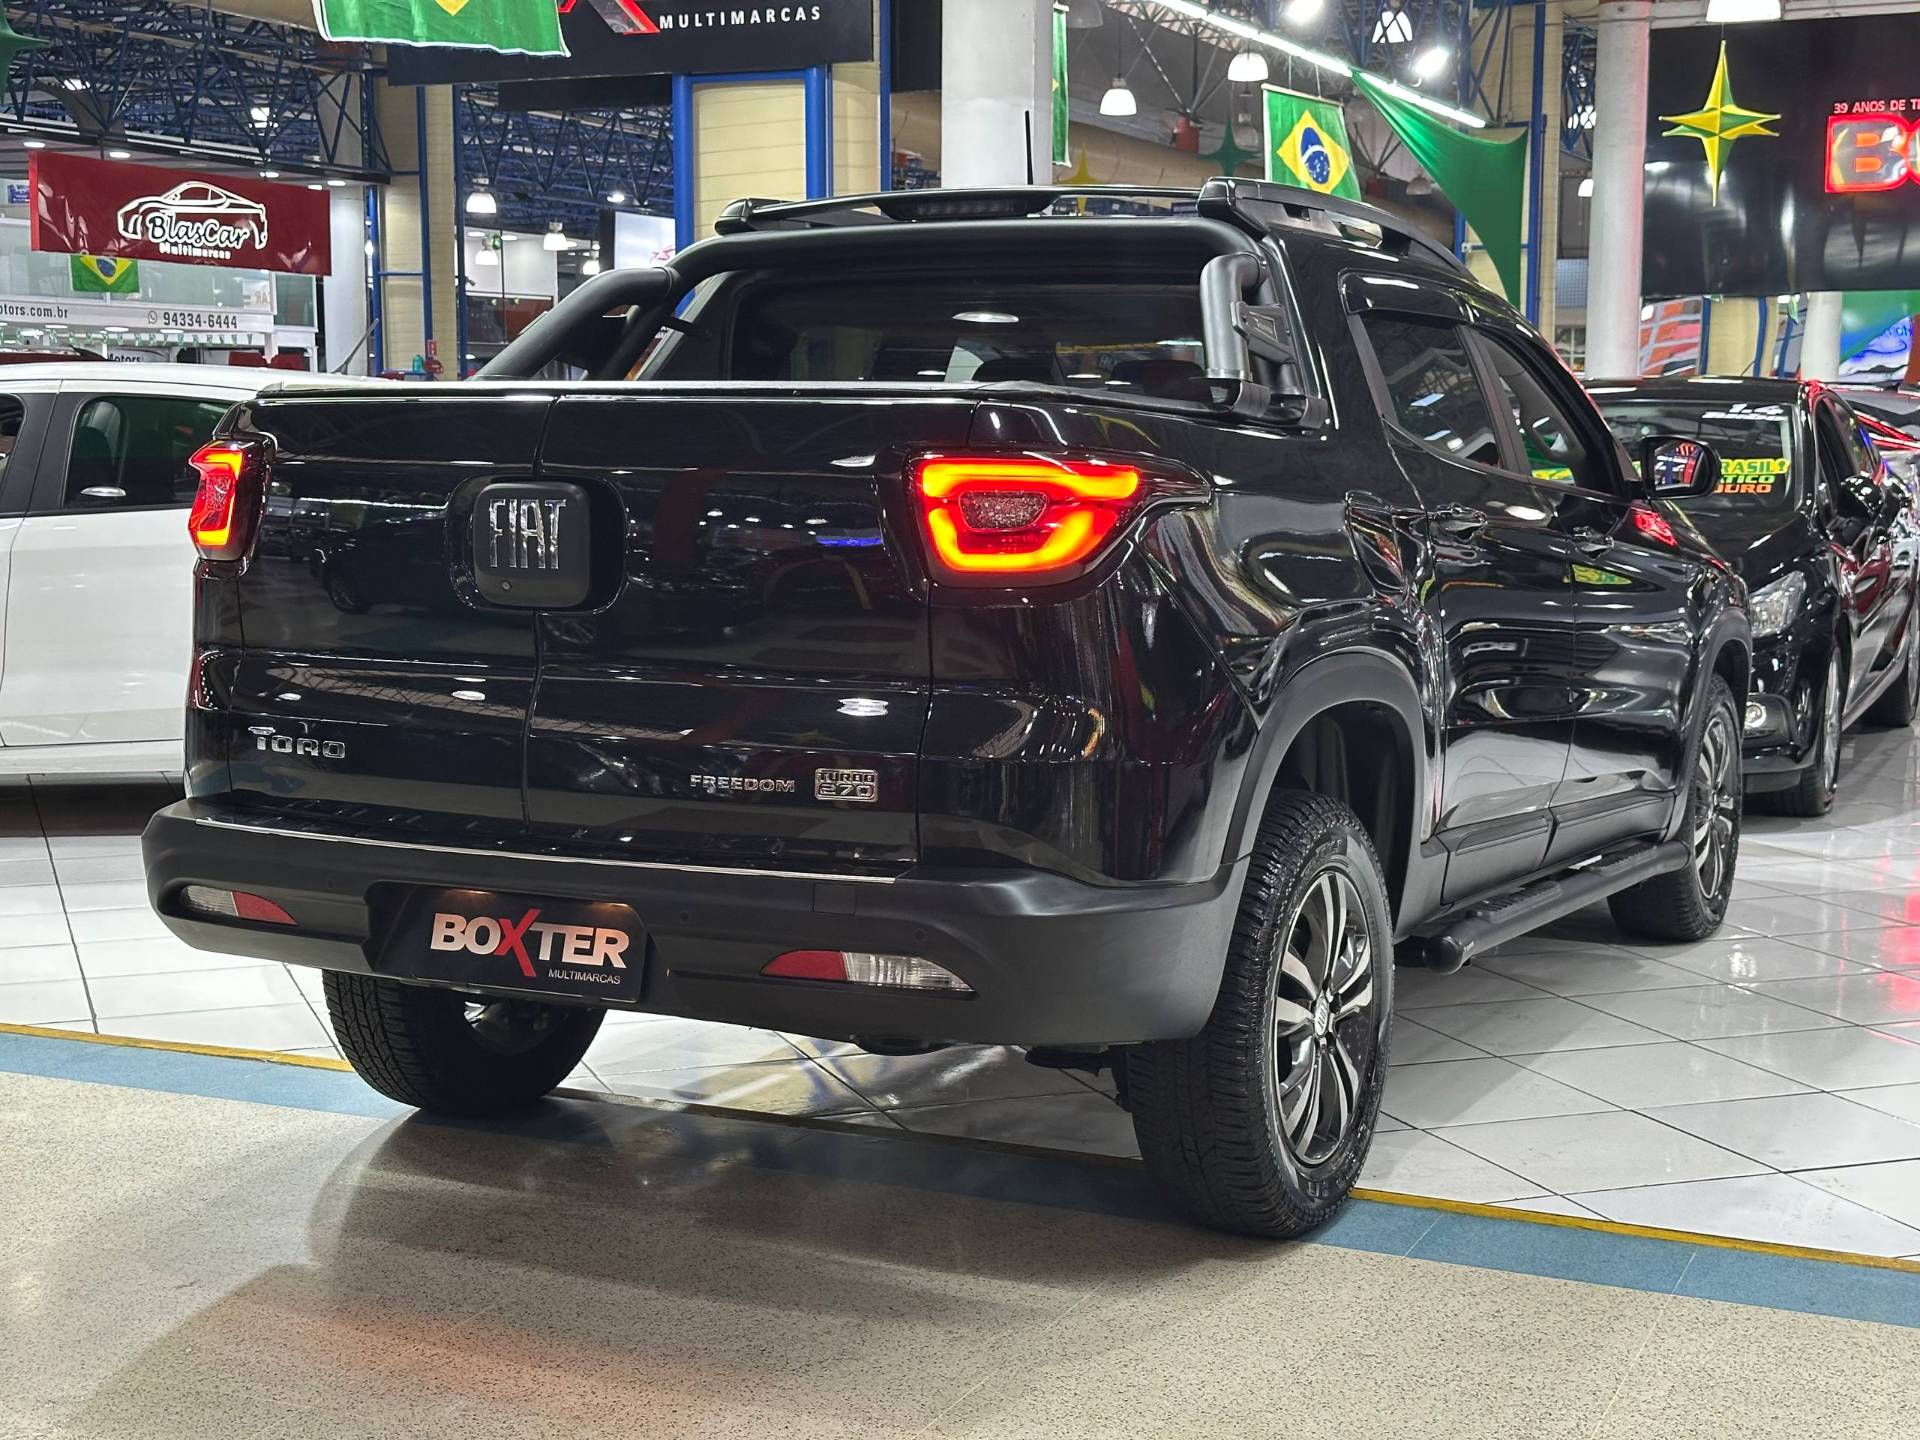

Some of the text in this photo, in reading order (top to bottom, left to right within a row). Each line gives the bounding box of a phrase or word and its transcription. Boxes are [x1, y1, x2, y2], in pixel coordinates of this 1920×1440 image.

[659, 6, 821, 30] MULTIMARCAS
[1833, 102, 1848, 114] 39
[1852, 101, 1885, 113] ANOS
[1890, 99, 1906, 111] DE
[1824, 114, 1920, 194] B
[147, 212, 249, 248] BlasCar
[159, 243, 231, 260] Multimarcas
[163, 311, 238, 329] 94334-6444
[1720, 460, 1776, 475] RASIL
[489, 499, 567, 569] FIAT
[690, 774, 796, 793] FREEDOM
[818, 770, 875, 784] TURBO
[820, 784, 874, 797] 270
[430, 908, 630, 978] BOXTER
[548, 968, 621, 985] MULTIMARCAS
